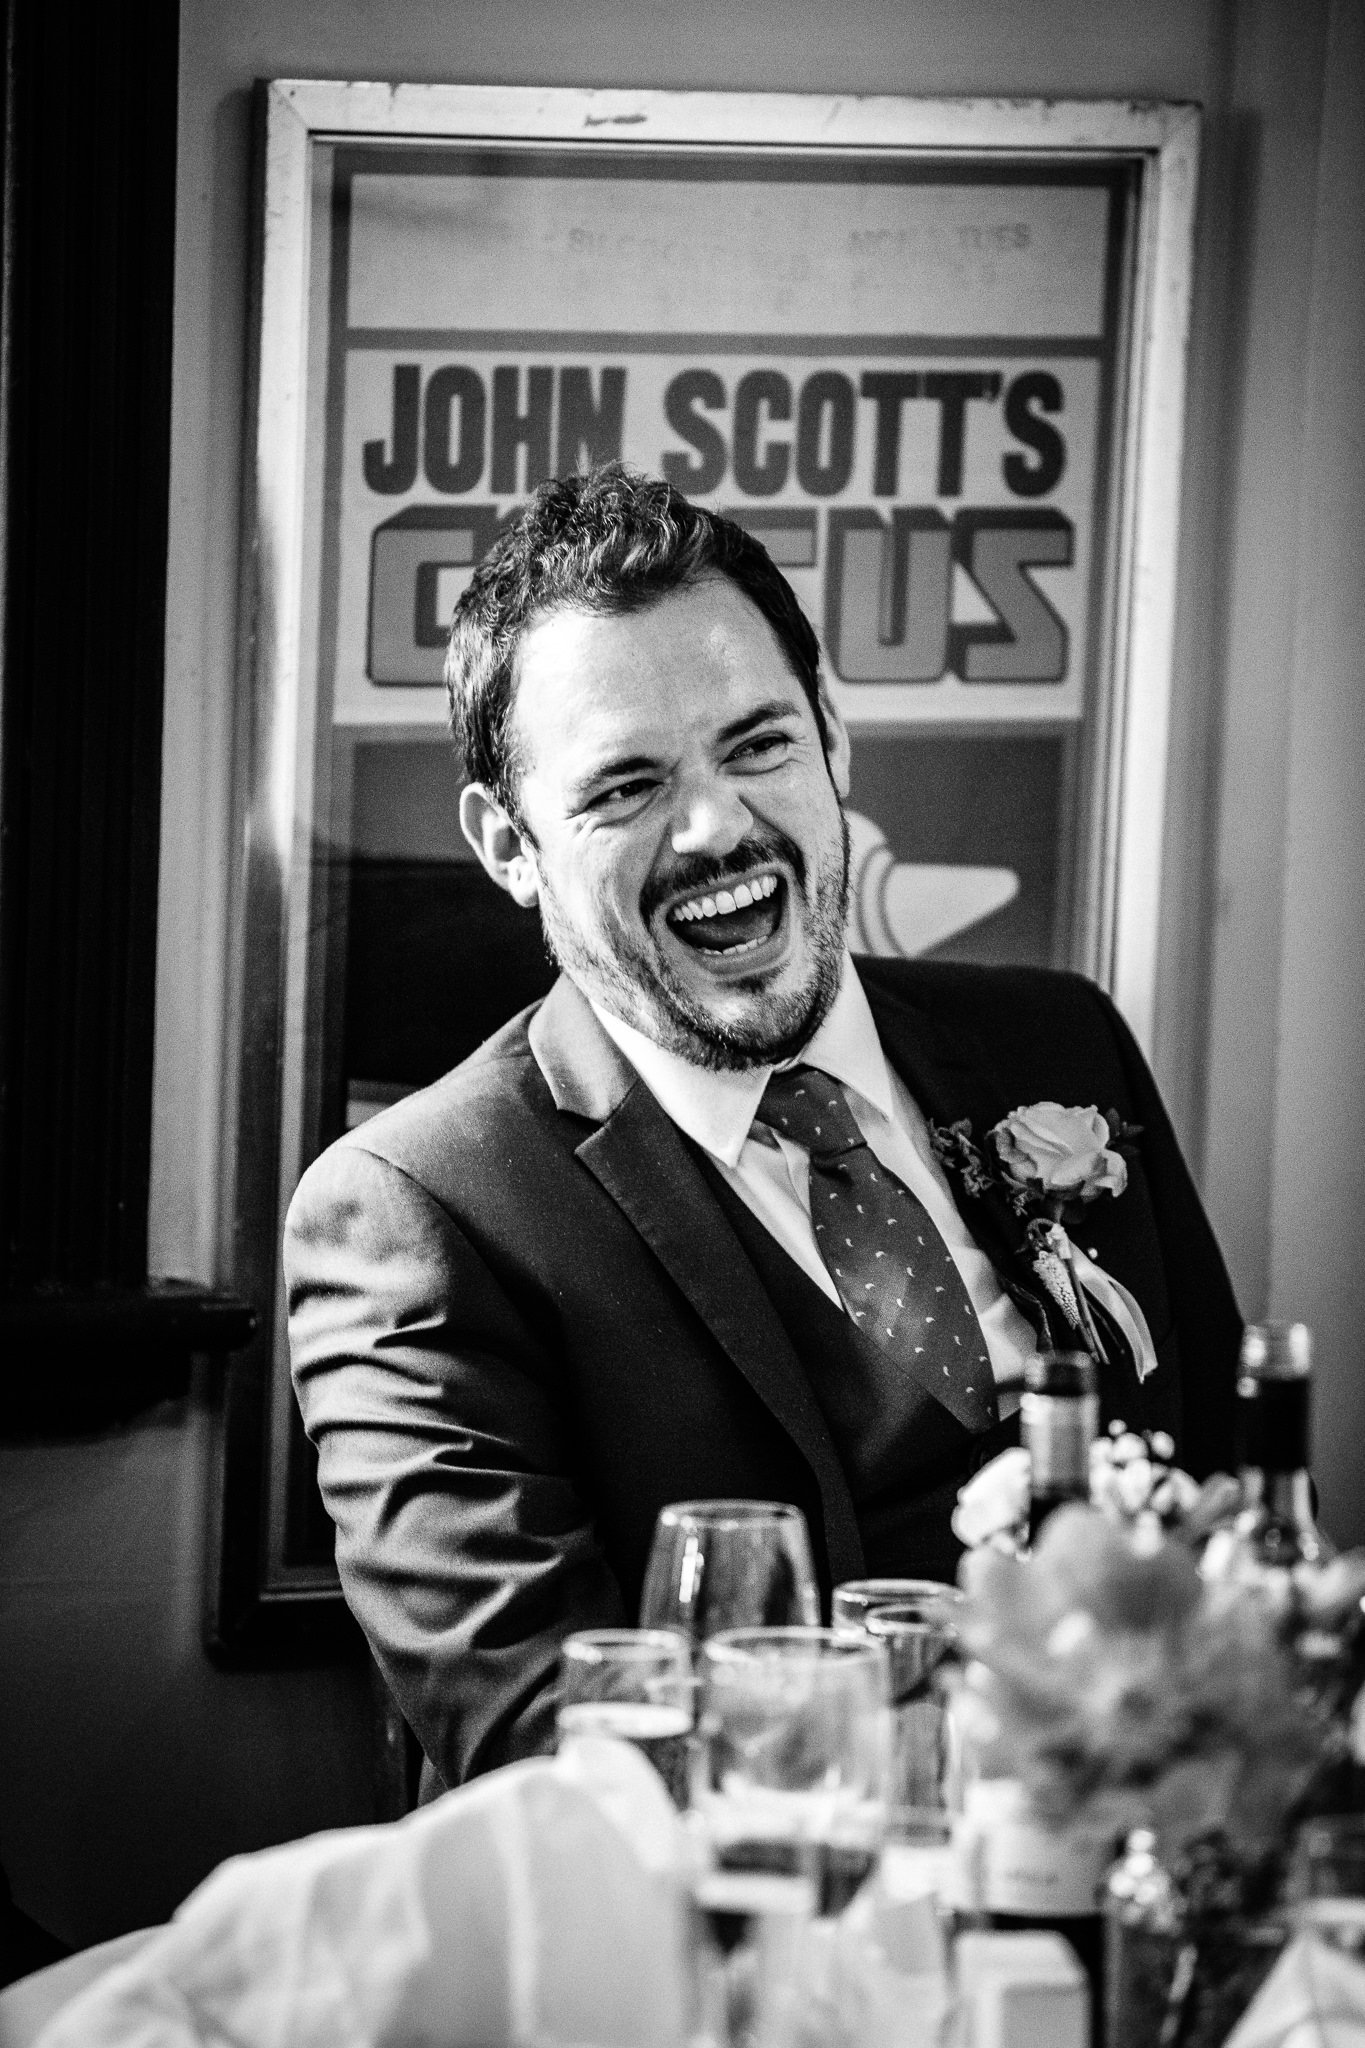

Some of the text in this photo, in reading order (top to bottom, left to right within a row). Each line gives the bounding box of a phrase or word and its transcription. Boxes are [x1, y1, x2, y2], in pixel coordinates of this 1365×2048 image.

[363, 364, 1066, 497] JOHN SCOTT'S
[366, 503, 1074, 687] CUS
